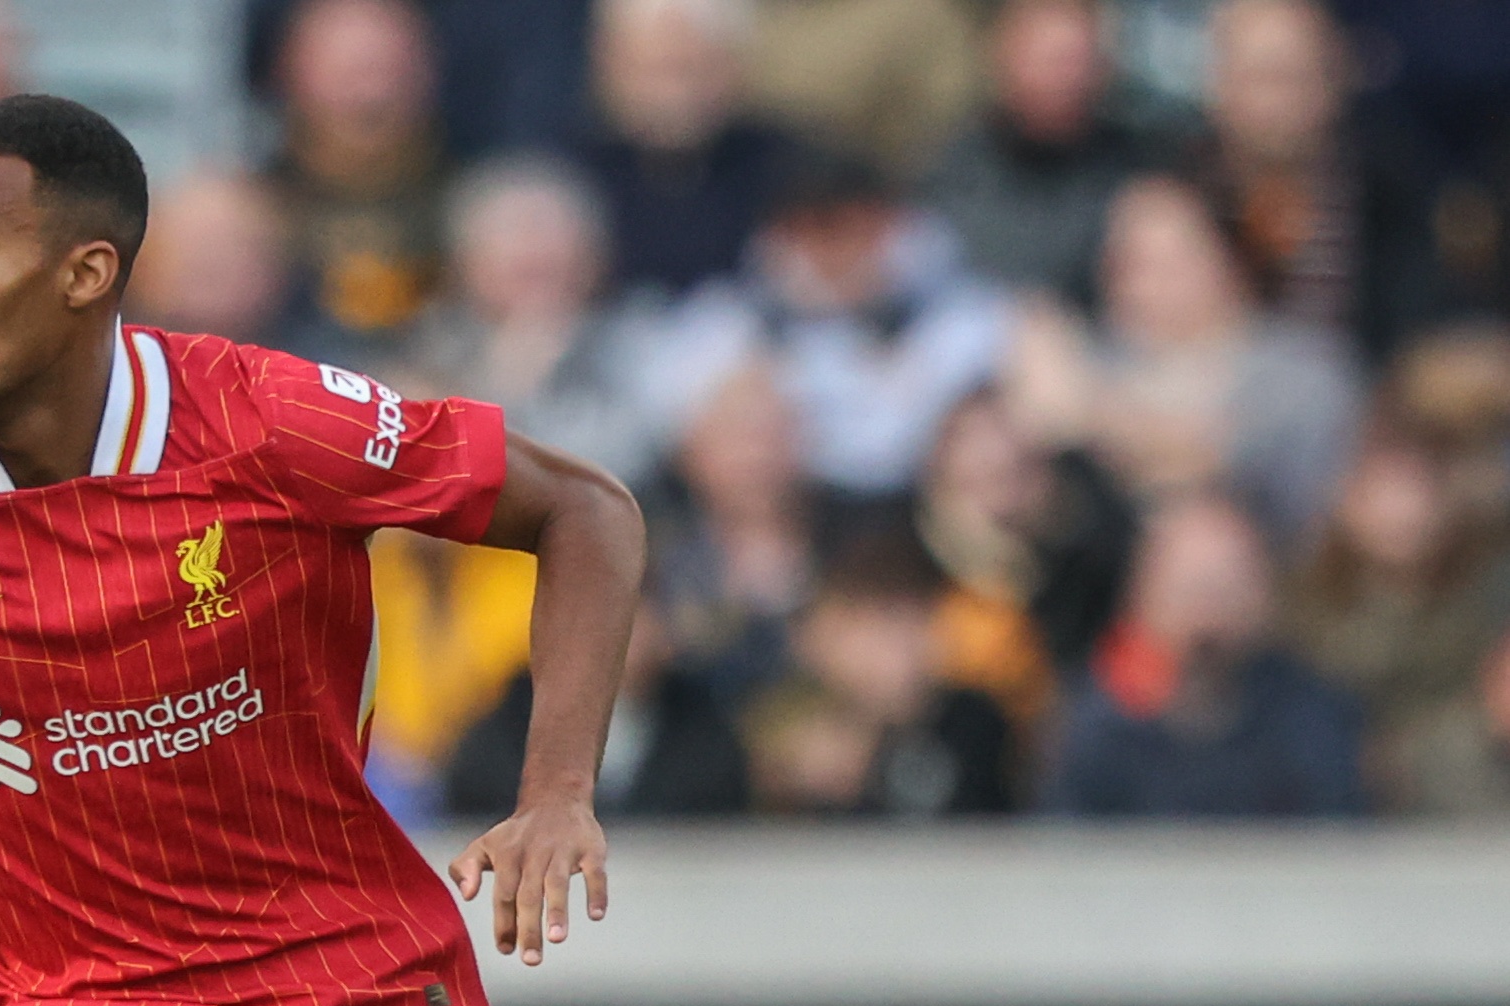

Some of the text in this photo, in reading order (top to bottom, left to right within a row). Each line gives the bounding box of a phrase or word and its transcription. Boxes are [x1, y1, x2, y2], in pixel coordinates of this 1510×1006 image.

[364, 383, 406, 470] Expe
[184, 597, 240, 629] L.F.C.
[45, 667, 248, 742] standard
[52, 688, 264, 776] chartered
